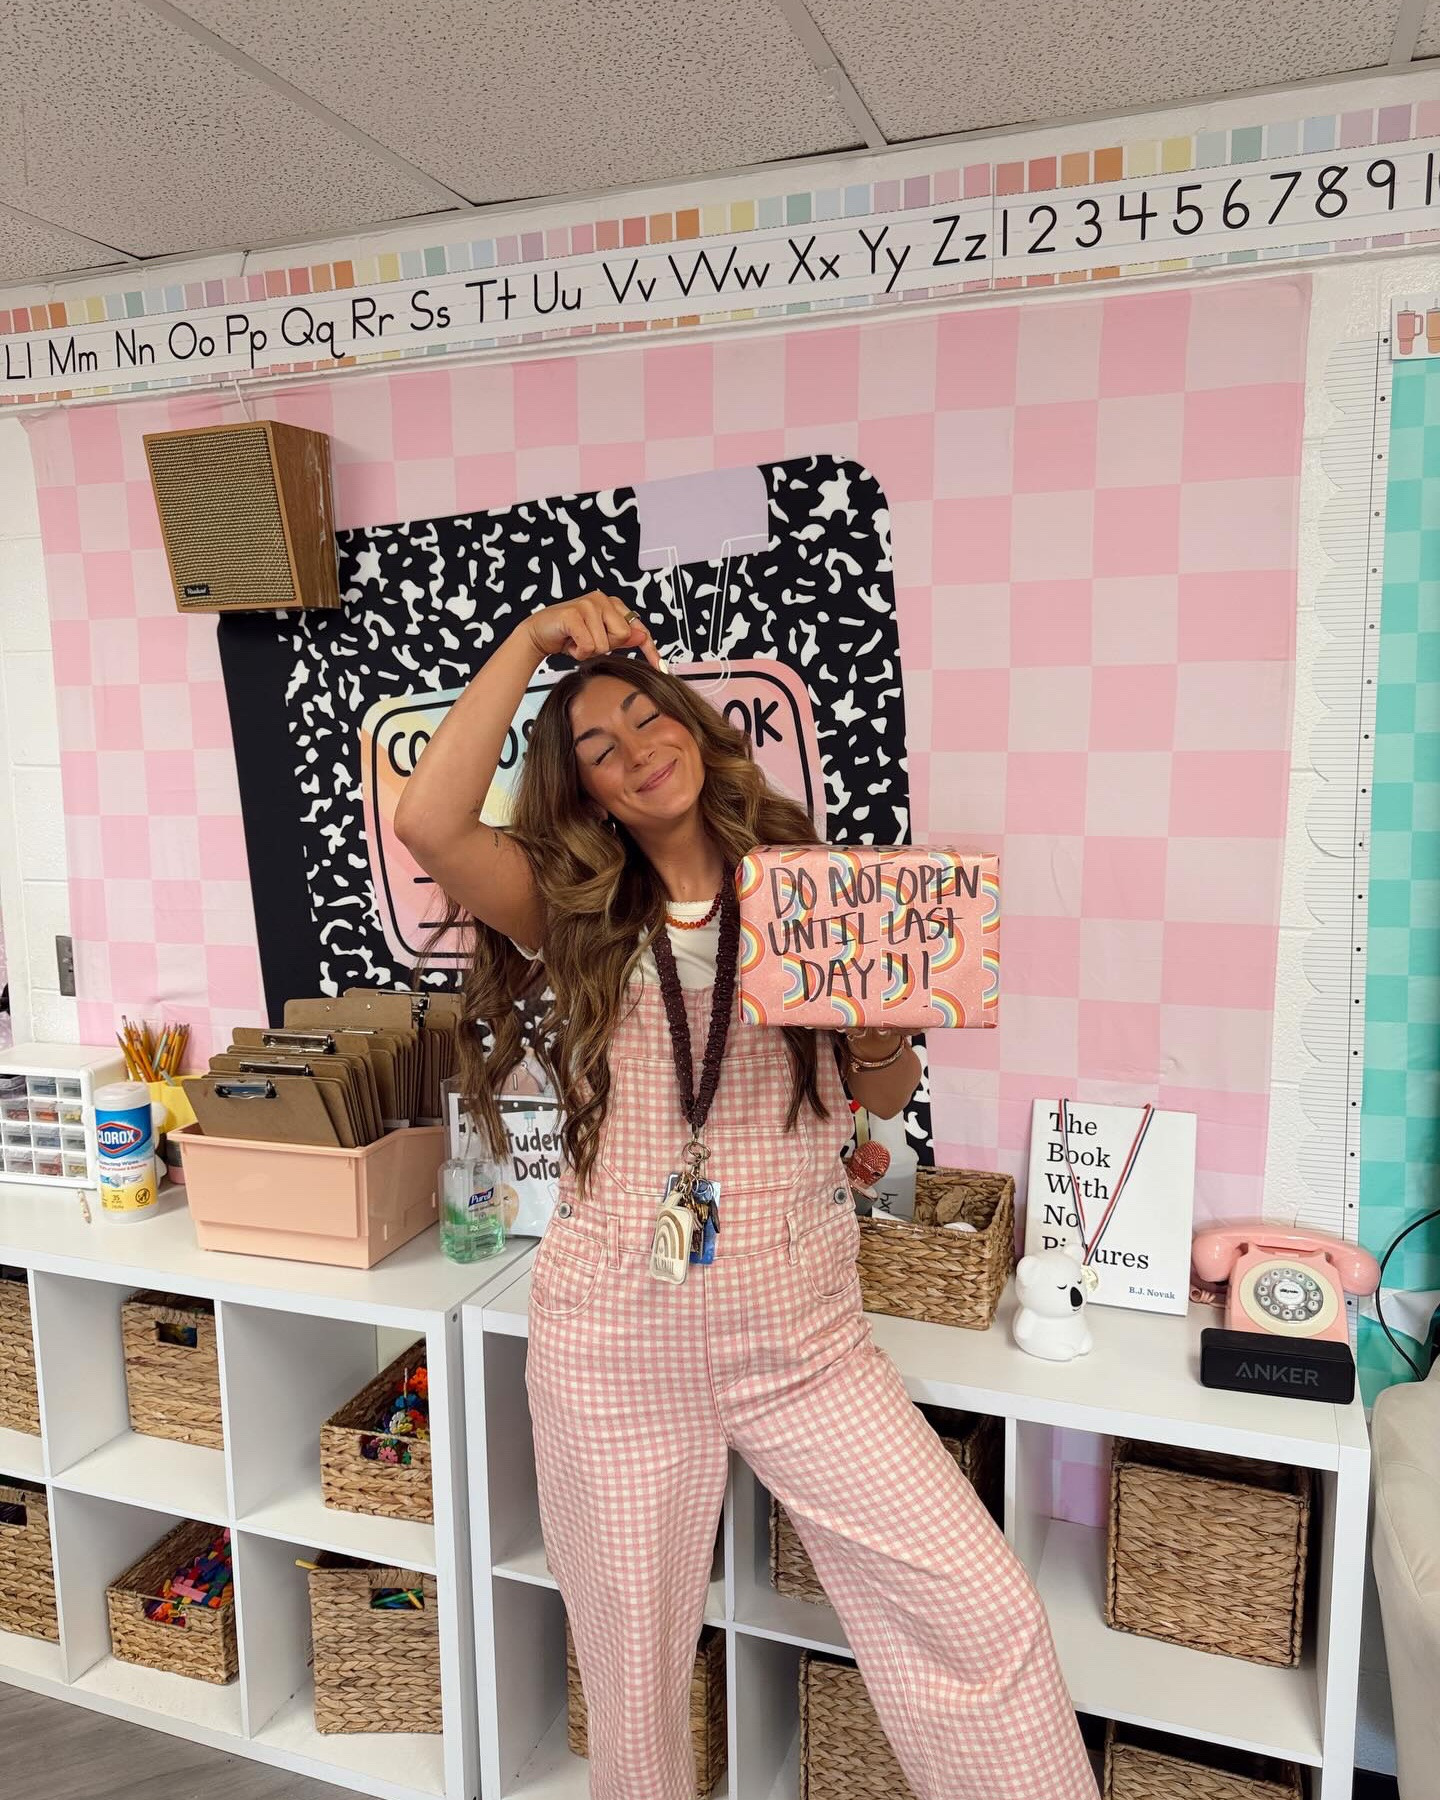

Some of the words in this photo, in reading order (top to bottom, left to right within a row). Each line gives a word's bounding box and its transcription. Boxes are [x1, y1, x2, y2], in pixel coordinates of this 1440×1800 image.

[1002, 209, 1008, 256] 1
[1028, 206, 1058, 254] 2
[1075, 200, 1102, 248] 3
[1119, 192, 1158, 241] 4
[1173, 184, 1204, 235] 5
[1222, 178, 1250, 229] 6
[1269, 171, 1302, 225] 7
[1315, 165, 1349, 218] 8
[1367, 159, 1396, 210] 9
[1424, 153, 1440, 205] 1
[48, 336, 98, 376] Mm
[115, 329, 155, 367] Nn
[168, 321, 215, 360] Oo
[225, 314, 268, 369] Pp
[281, 307, 346, 359] Qq
[352, 297, 395, 340] Rr
[410, 289, 451, 331] Ss
[465, 279, 517, 323] Tt
[533, 270, 582, 314] Uu
[602, 258, 657, 304] Vv
[667, 246, 770, 297] Ww
[788, 235, 841, 285] Xx
[858, 225, 911, 293] Yy
[931, 214, 987, 267] Zz
[722, 697, 783, 748] OK
[769, 866, 817, 919] DO
[827, 861, 895, 908] NOT
[895, 864, 980, 905] OPEN
[767, 911, 880, 957] UNTIL
[1049, 1112, 1098, 1136] The
[505, 1127, 562, 1153] tuden
[512, 1154, 561, 1181] Data
[1046, 1142, 1111, 1168] Book
[1044, 1172, 1110, 1200] With
[1042, 1204, 1079, 1228] No
[1146, 1288, 1176, 1300] Novak
[1235, 1361, 1319, 1387] ANKER
